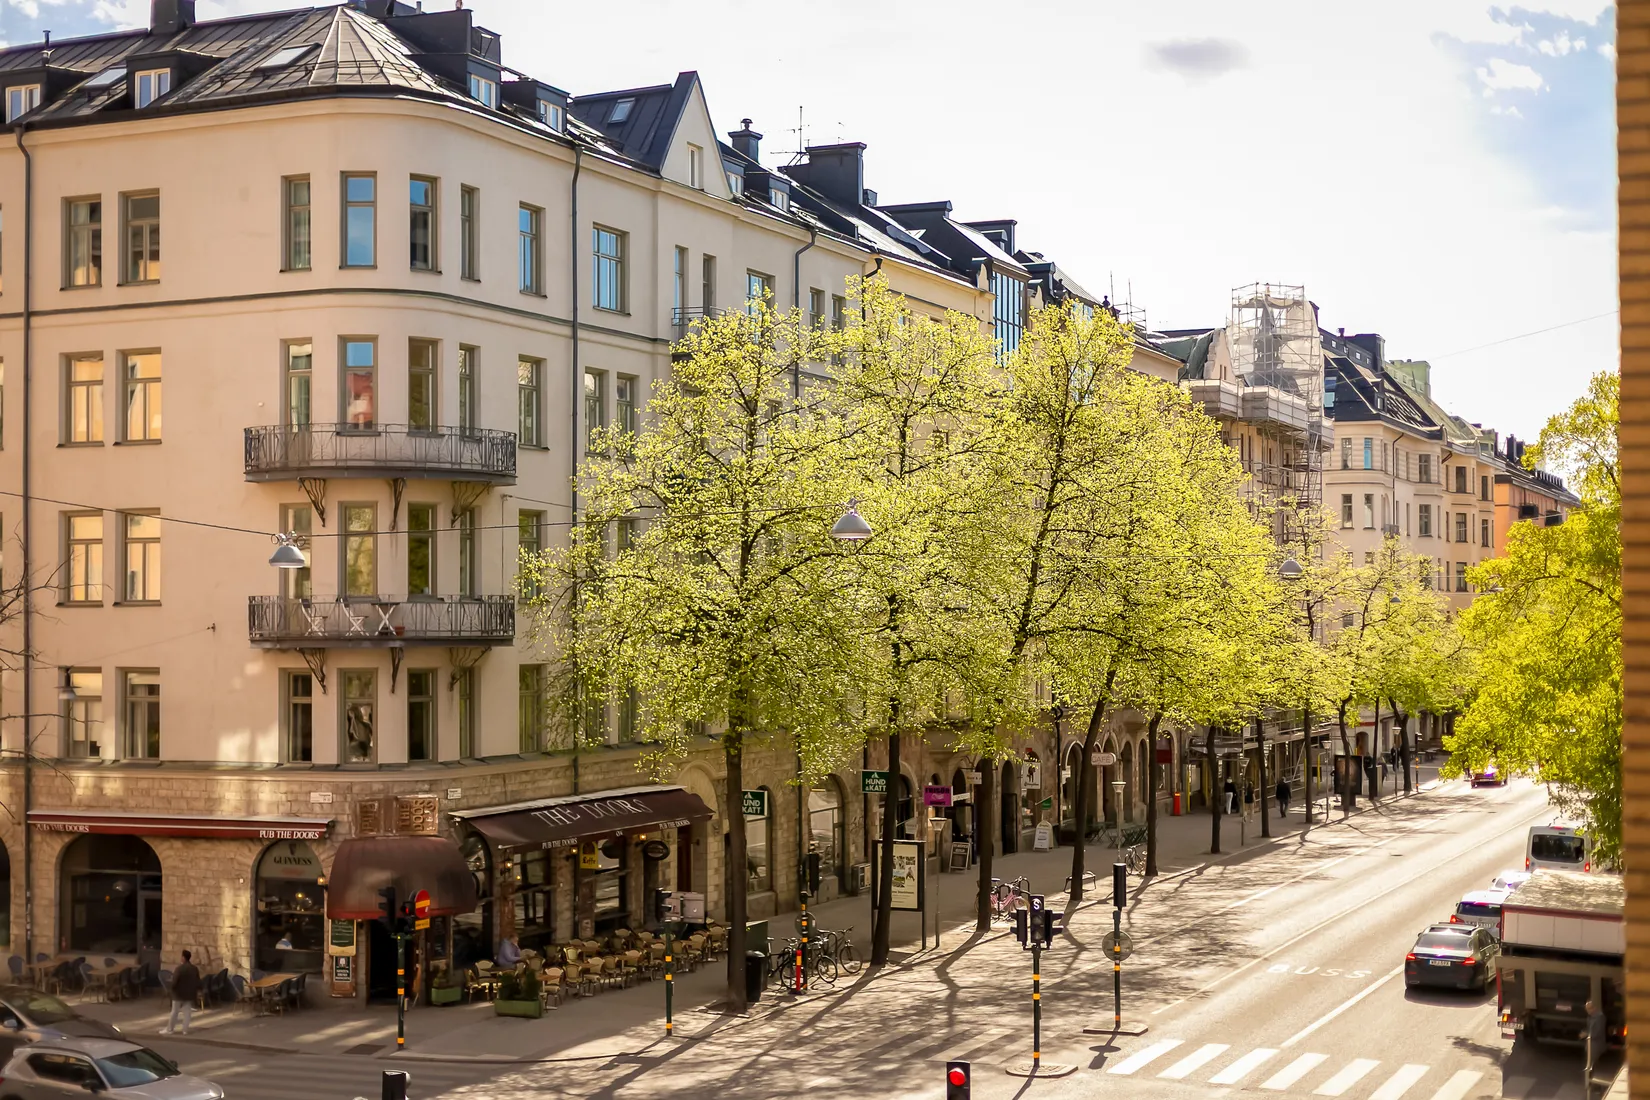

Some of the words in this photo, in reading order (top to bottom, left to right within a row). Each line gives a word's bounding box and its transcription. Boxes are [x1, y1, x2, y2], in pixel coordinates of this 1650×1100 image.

[531, 806, 581, 827] THE
[578, 798, 654, 819] DOORS
[65, 824, 90, 833] DOORS
[259, 830, 275, 839] PUB
[276, 830, 292, 839] THE
[293, 831, 320, 840] DOORS
[542, 841, 552, 850] PUB
[552, 840, 562, 848] THE
[561, 837, 578, 846] DOORS
[273, 856, 313, 866] GUINNESS
[1267, 964, 1372, 979] BUSS
